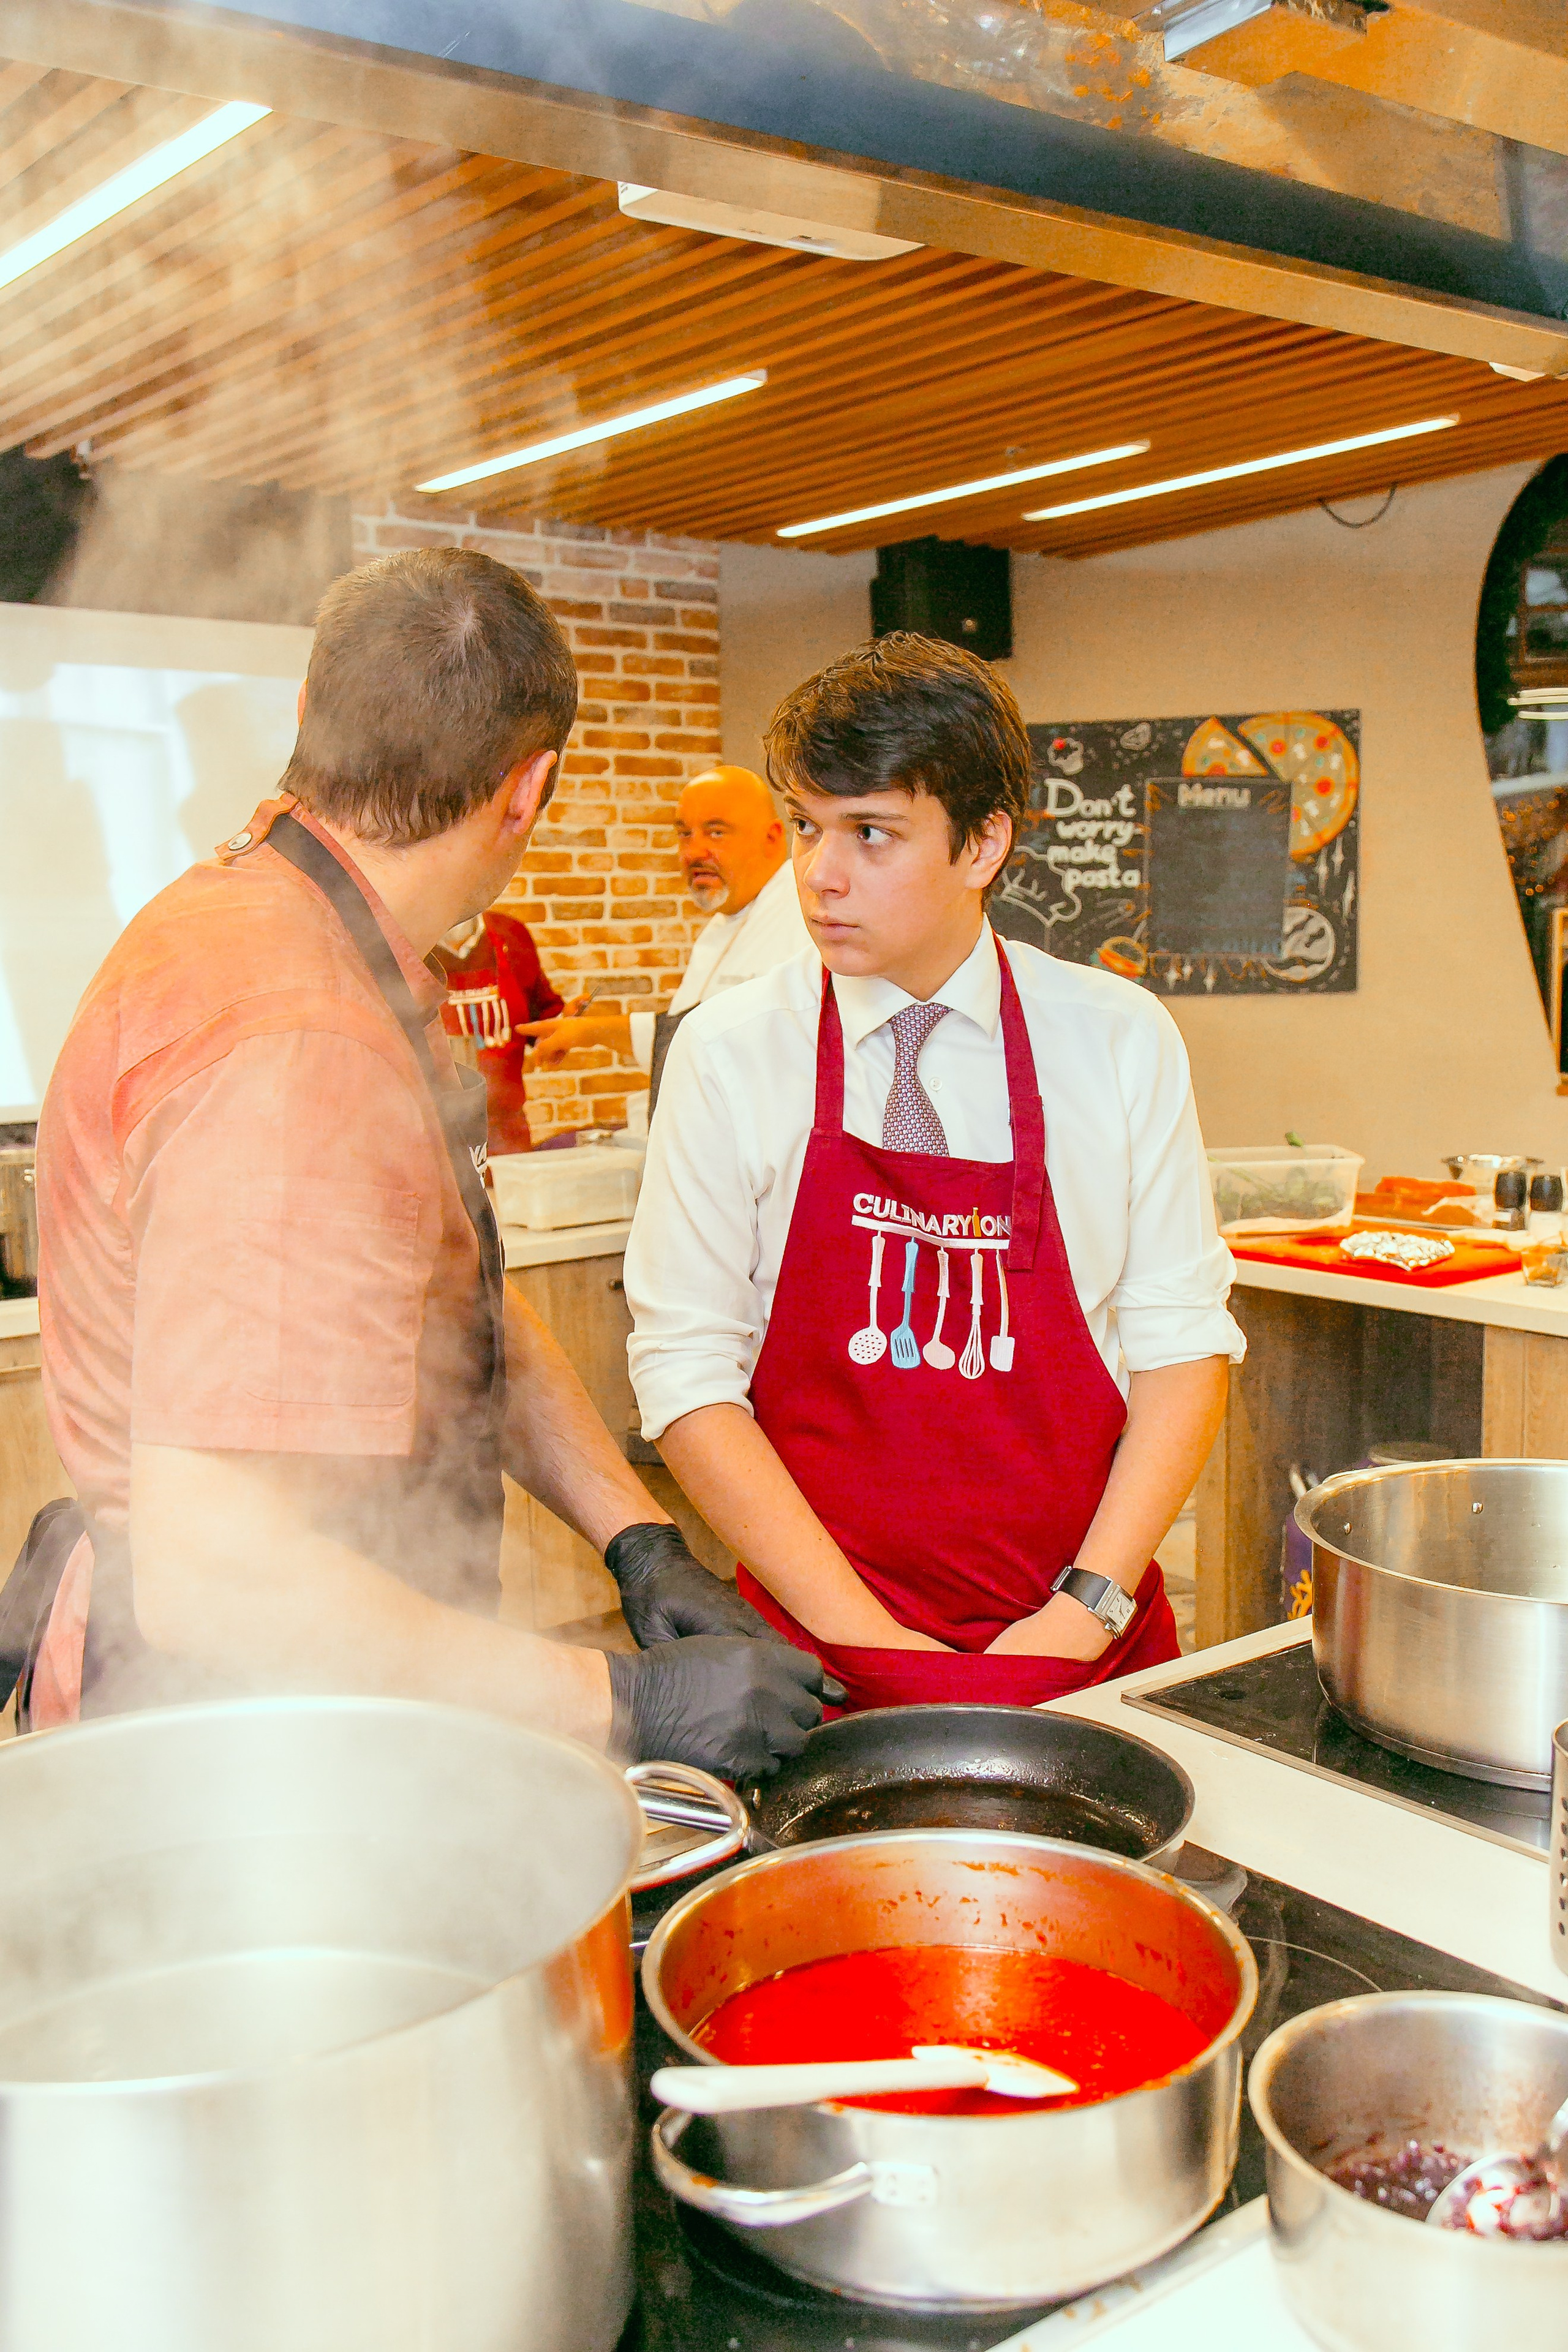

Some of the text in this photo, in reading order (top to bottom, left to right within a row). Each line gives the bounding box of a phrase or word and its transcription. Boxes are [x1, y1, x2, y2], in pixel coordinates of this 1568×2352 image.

[1044, 778, 1137, 818] Don't
[1177, 782, 1251, 809] Menu
[1055, 820, 1134, 847] worry
[1047, 839, 1118, 865] make
[1061, 863, 1142, 895] pasta
